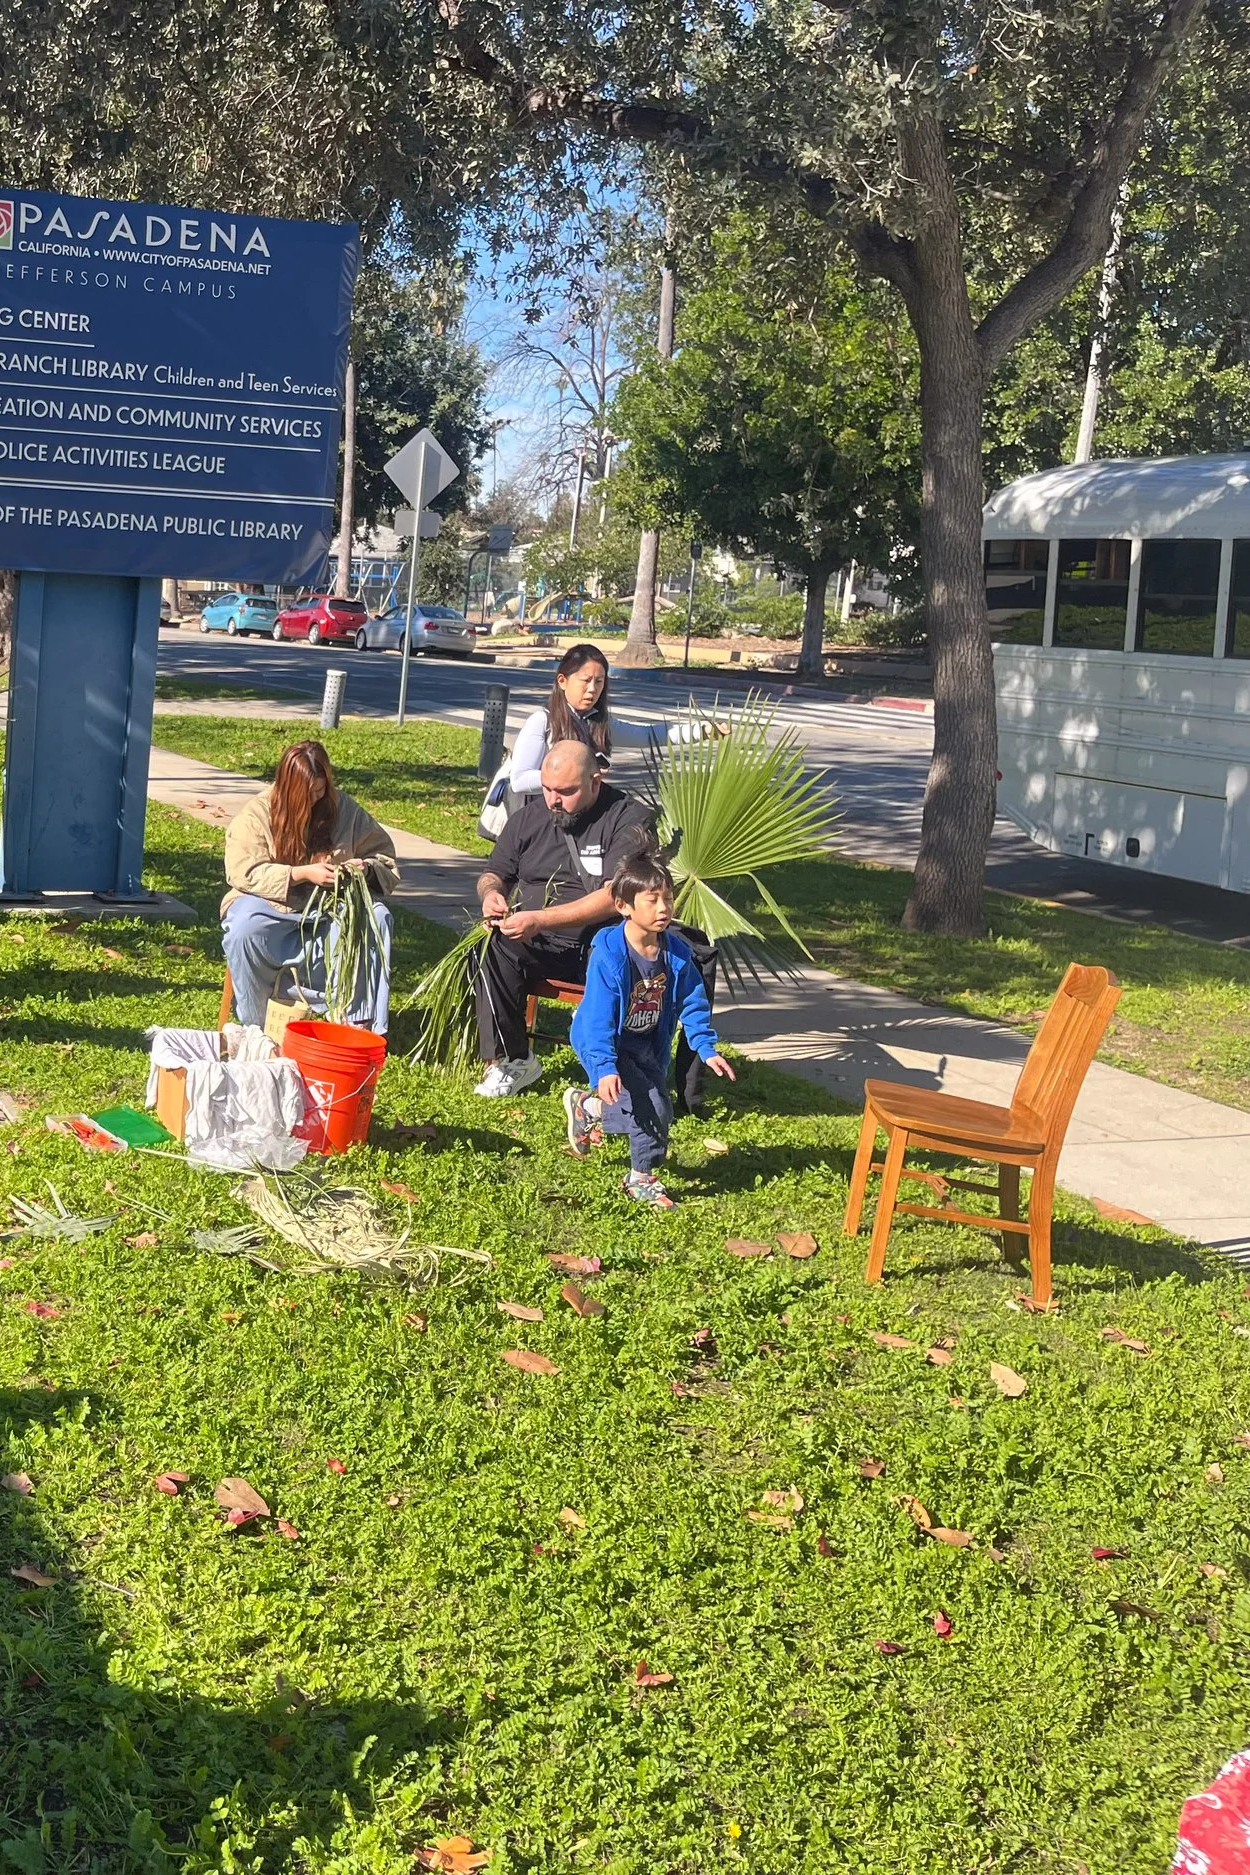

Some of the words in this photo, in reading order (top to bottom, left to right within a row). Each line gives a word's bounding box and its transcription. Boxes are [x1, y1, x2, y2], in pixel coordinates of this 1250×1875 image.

[18, 203, 271, 258] PASADENA
[18, 241, 91, 258] CALIFORNIA
[103, 249, 272, 275] WWW.CITYOFPASADENA.NET
[144, 277, 235, 299] CAMPUS
[19, 309, 90, 333] CENTER
[72, 358, 149, 381] LIBRARY
[154, 365, 214, 387] Children
[218, 372, 244, 389] and
[248, 373, 279, 392] Teen
[282, 376, 337, 397] Services
[68, 403, 111, 422] AND
[116, 406, 236, 432] COMMUNITY
[240, 416, 322, 438] SERVICES
[52, 446, 148, 468] ACTIVITIES
[153, 453, 226, 474] LEAGUE
[20, 507, 53, 526] THE
[58, 510, 158, 532] PASADENA
[163, 516, 226, 536] PUBLIC
[230, 520, 303, 540] LIBRARY
